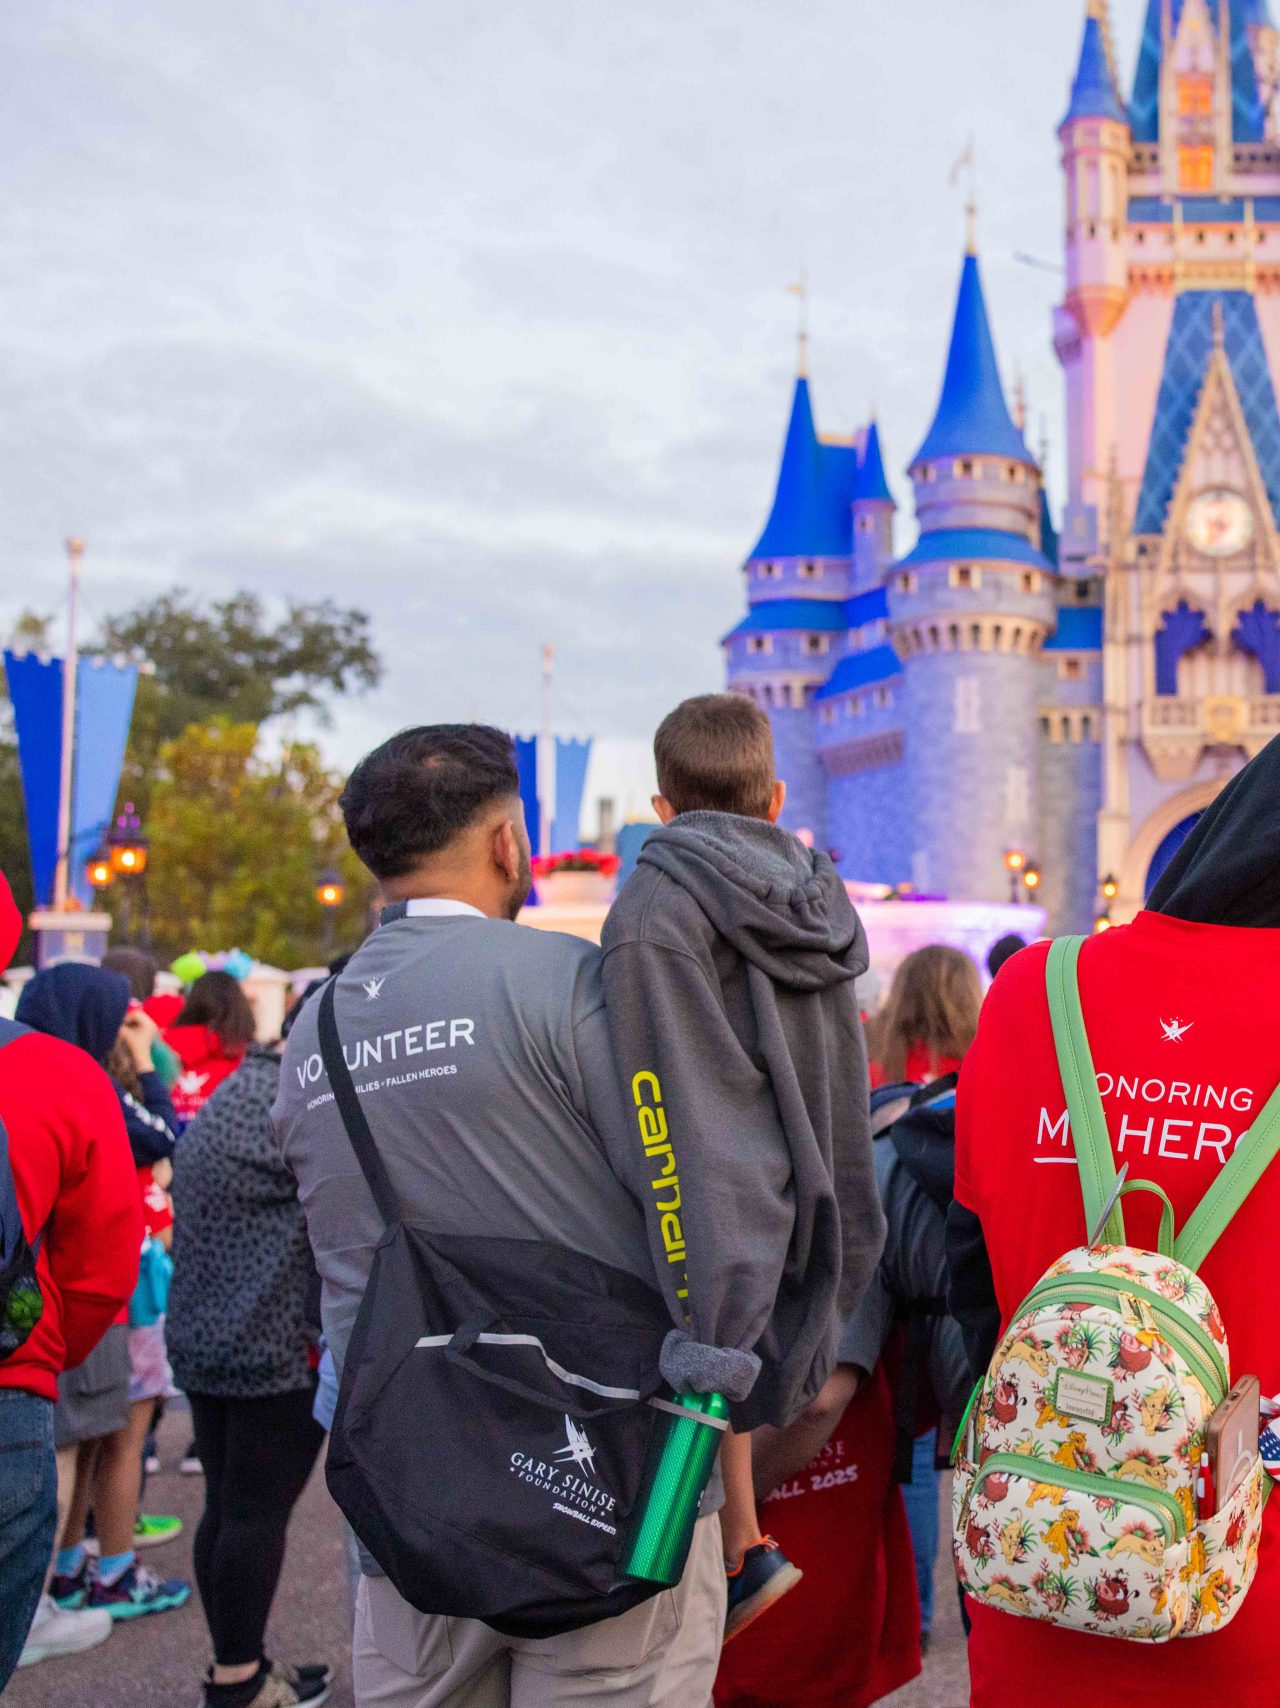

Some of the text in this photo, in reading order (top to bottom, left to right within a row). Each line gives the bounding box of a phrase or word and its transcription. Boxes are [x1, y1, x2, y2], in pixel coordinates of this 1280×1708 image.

[297, 1017, 476, 1089] VOUNTEER
[307, 1092, 335, 1111] HONORIN
[386, 1070, 418, 1088] FALLEN
[418, 1064, 458, 1081] HEROES
[1095, 1072, 1254, 1112] ONORING
[1036, 1106, 1250, 1165] M HER
[510, 1452, 616, 1512] GARY SINISE
[518, 1470, 598, 1513] FOUNDATION
[810, 1464, 859, 1492] 2025
[552, 1502, 591, 1524] SNOWBALL
